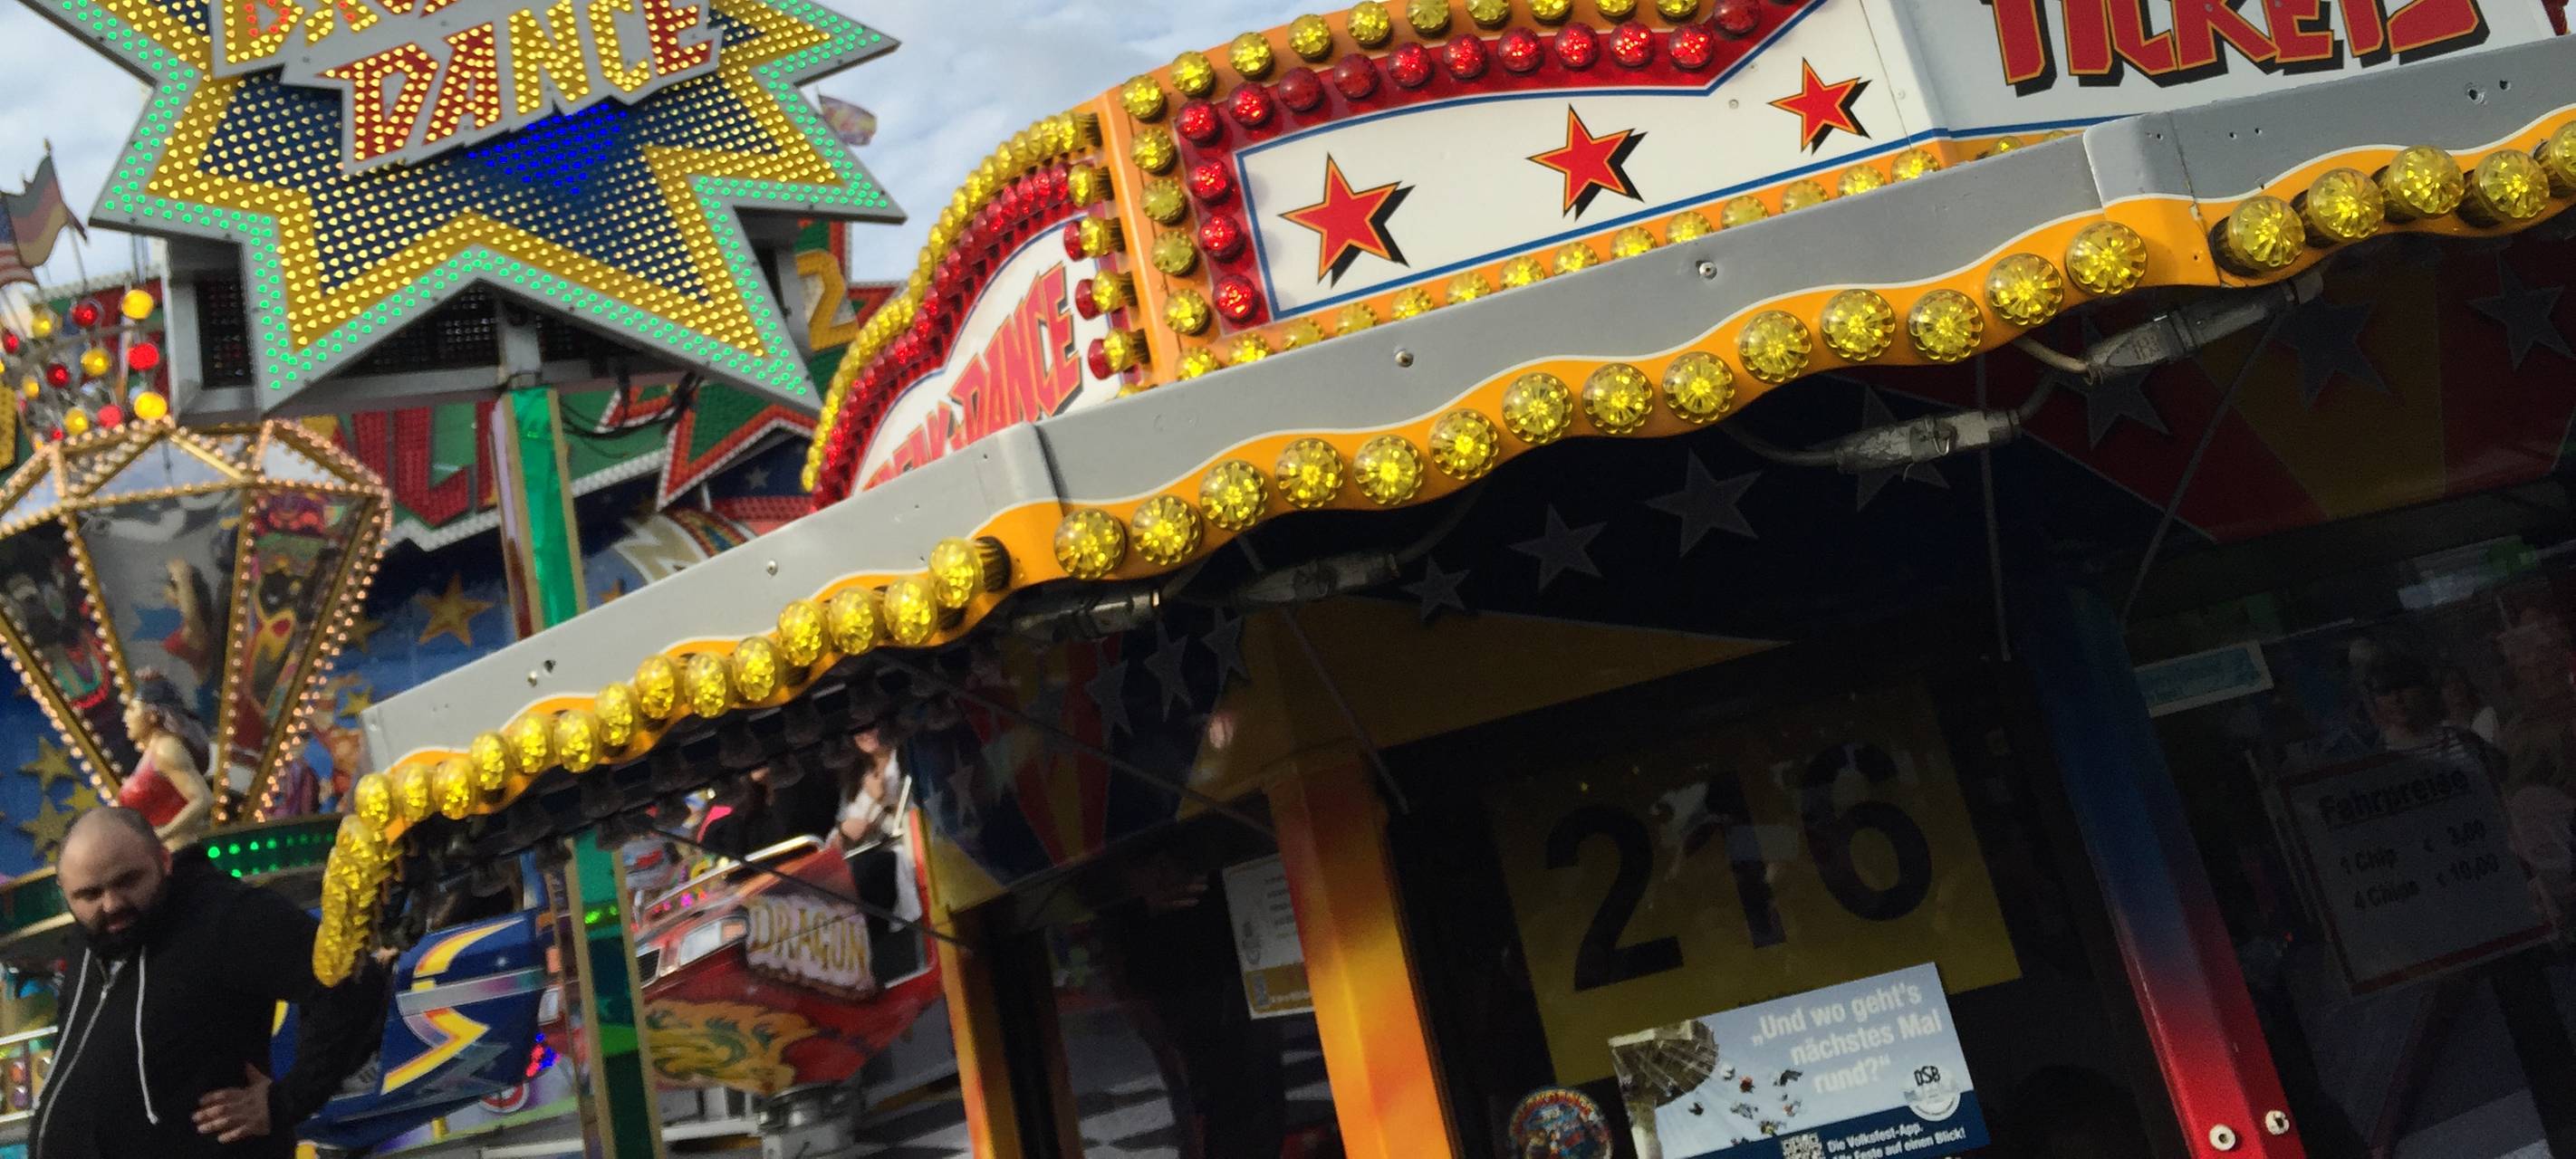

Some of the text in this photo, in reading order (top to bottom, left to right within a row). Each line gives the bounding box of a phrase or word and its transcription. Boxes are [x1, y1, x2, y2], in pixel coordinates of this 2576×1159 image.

[313, 0, 715, 163] DANCE
[947, 260, 1083, 454] DANCE
[2318, 769, 2471, 828] Fahrpreise
[1545, 742, 1934, 993] 216
[746, 904, 870, 981] DRAGON
[1789, 1008, 1944, 1067] nächstes Mal
[1810, 1002, 1846, 1028] wo
[1914, 1065, 1941, 1087] DSB
[1826, 1138, 1847, 1154] Die
[1884, 1140, 1903, 1156] auf
[1904, 1135, 1935, 1153] einen
[1934, 1126, 1967, 1145] Blick!
